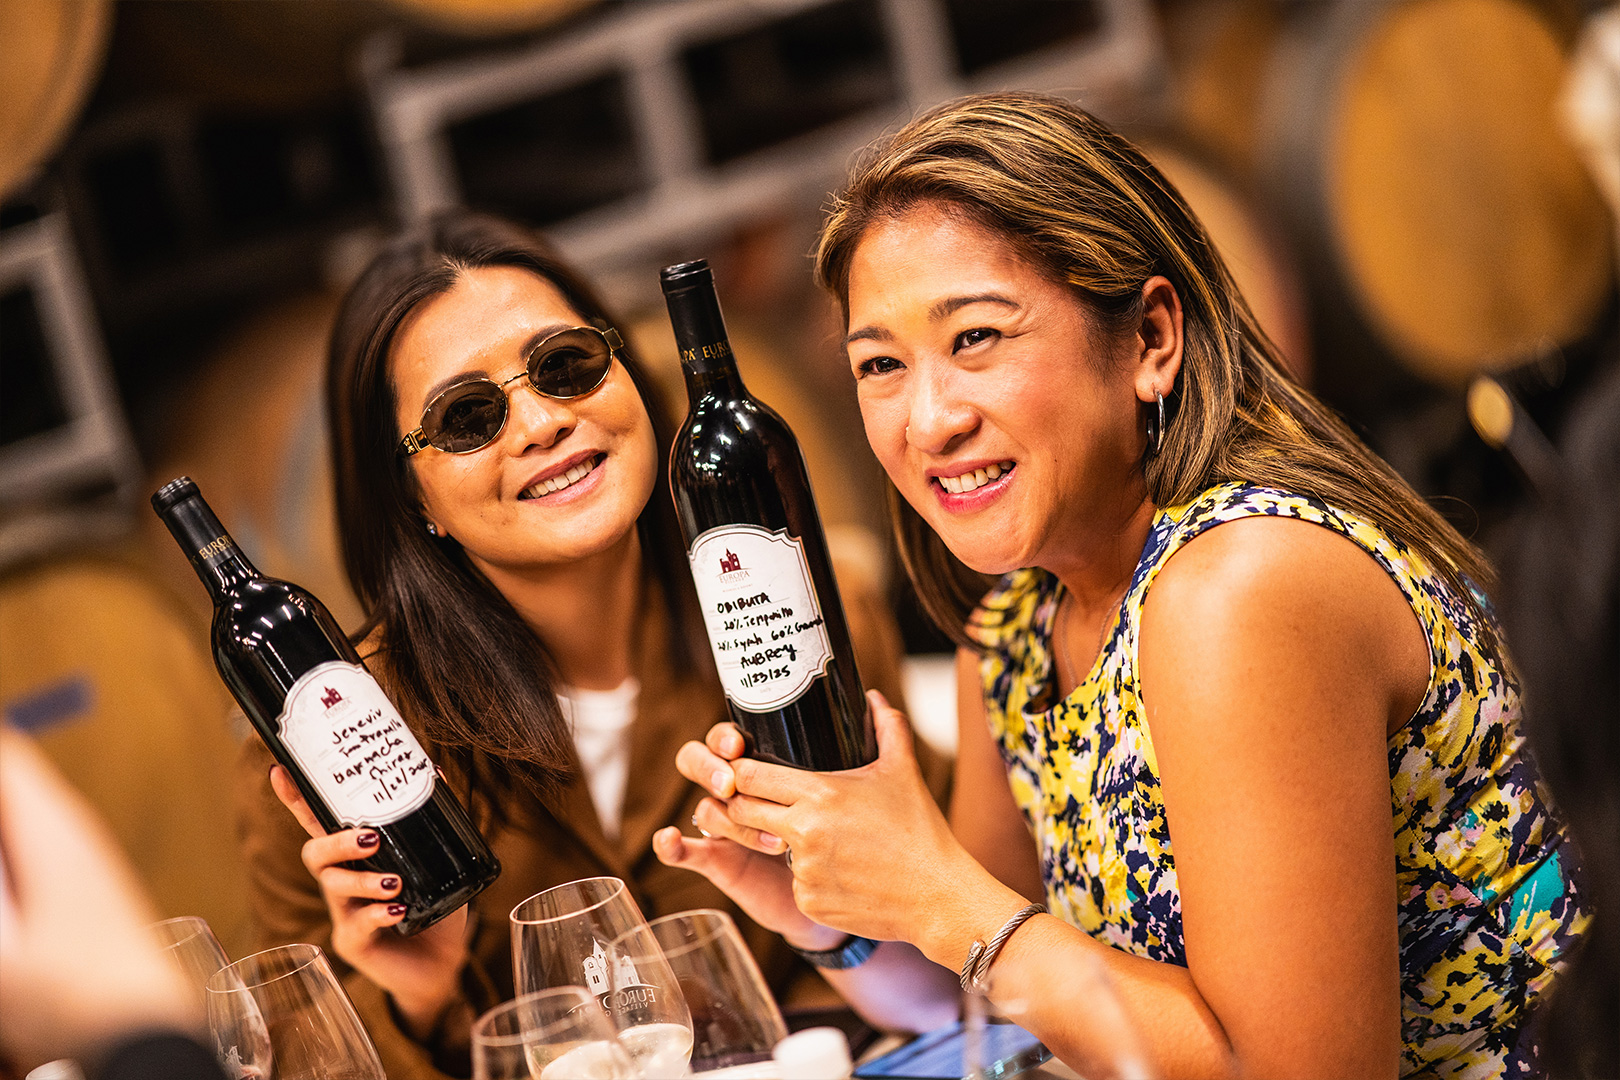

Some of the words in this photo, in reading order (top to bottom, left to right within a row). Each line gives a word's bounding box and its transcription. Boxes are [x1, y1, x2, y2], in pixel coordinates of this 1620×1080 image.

[199, 535, 233, 560] EUROP
[771, 625, 793, 641] 60%
[740, 664, 791, 687] 11/23/25
